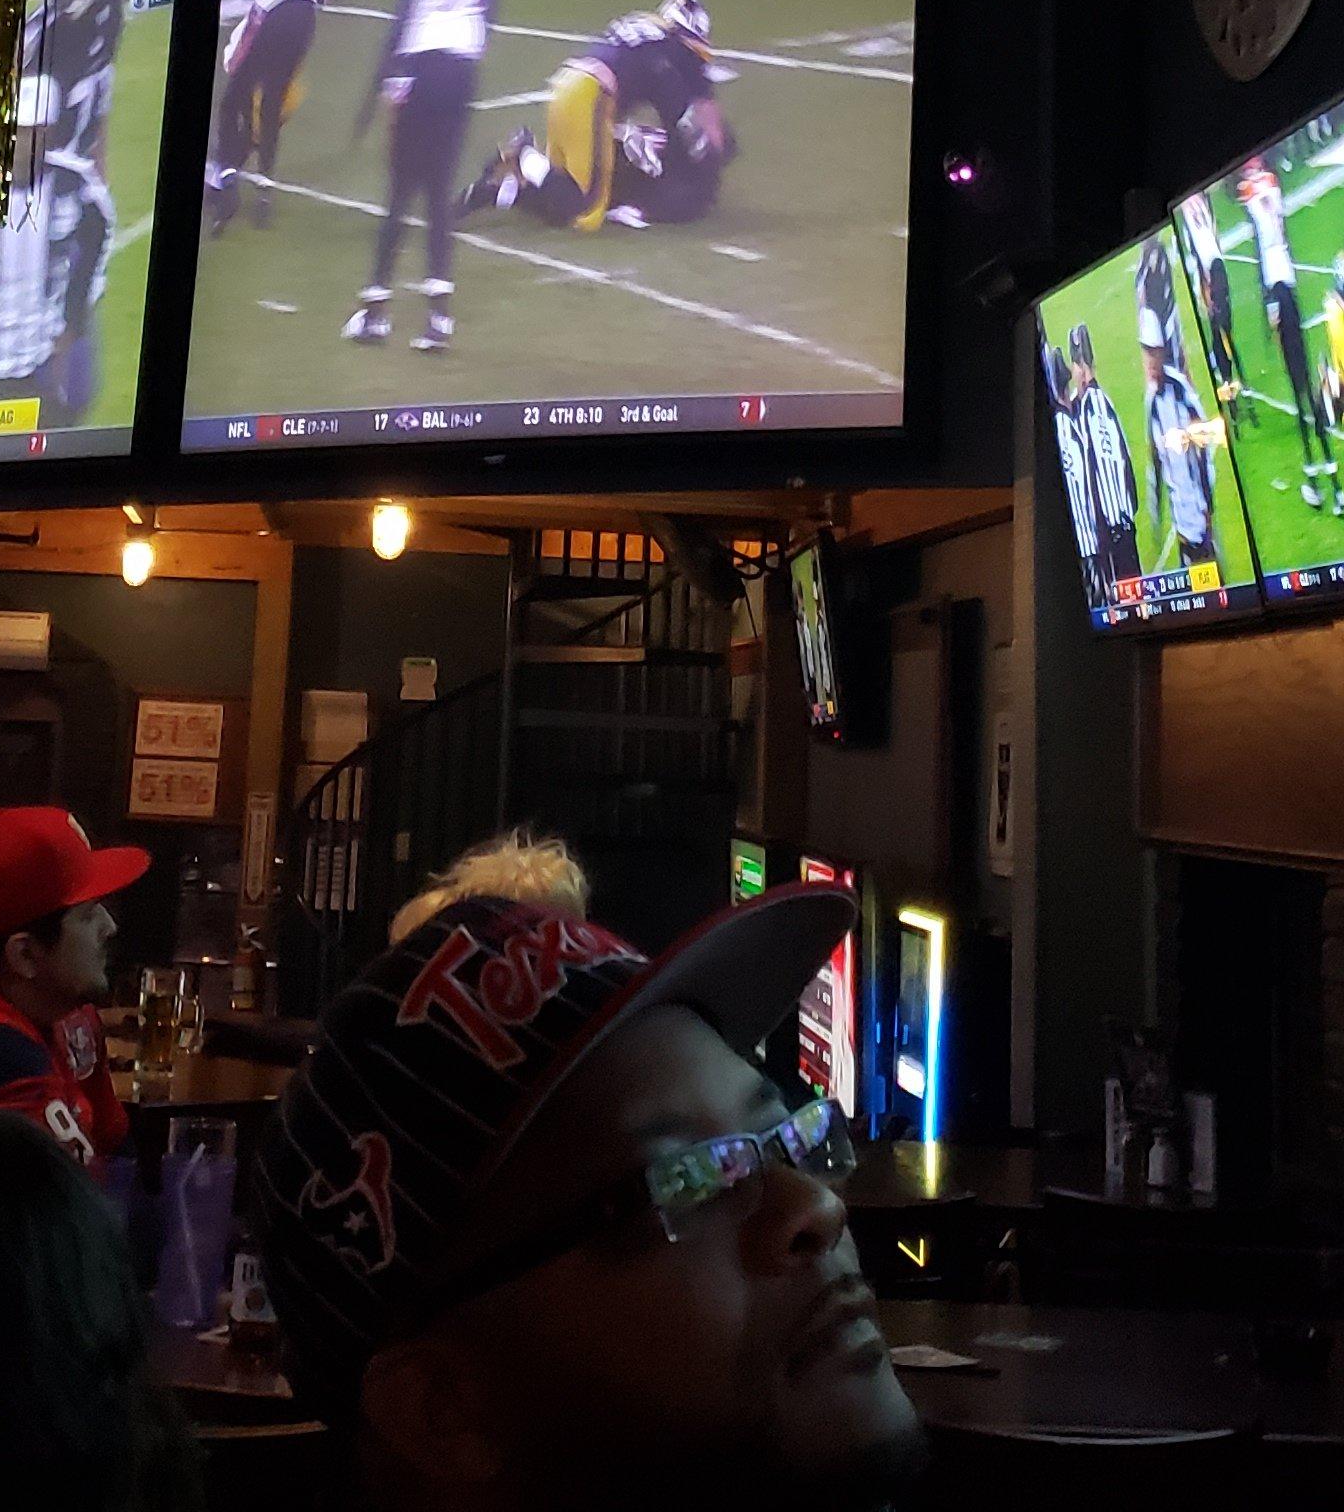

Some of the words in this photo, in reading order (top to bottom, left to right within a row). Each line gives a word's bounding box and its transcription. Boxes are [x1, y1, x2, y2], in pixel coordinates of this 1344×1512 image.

[228, 422, 251, 438] NFL
[282, 419, 306, 435] CLE
[374, 413, 389, 431] 17
[422, 411, 447, 428] BAL
[523, 407, 540, 425] 23
[549, 408, 573, 424] 4TH
[576, 407, 603, 424] 8:10
[620, 406, 639, 423] 3rd
[653, 405, 678, 422] Goal
